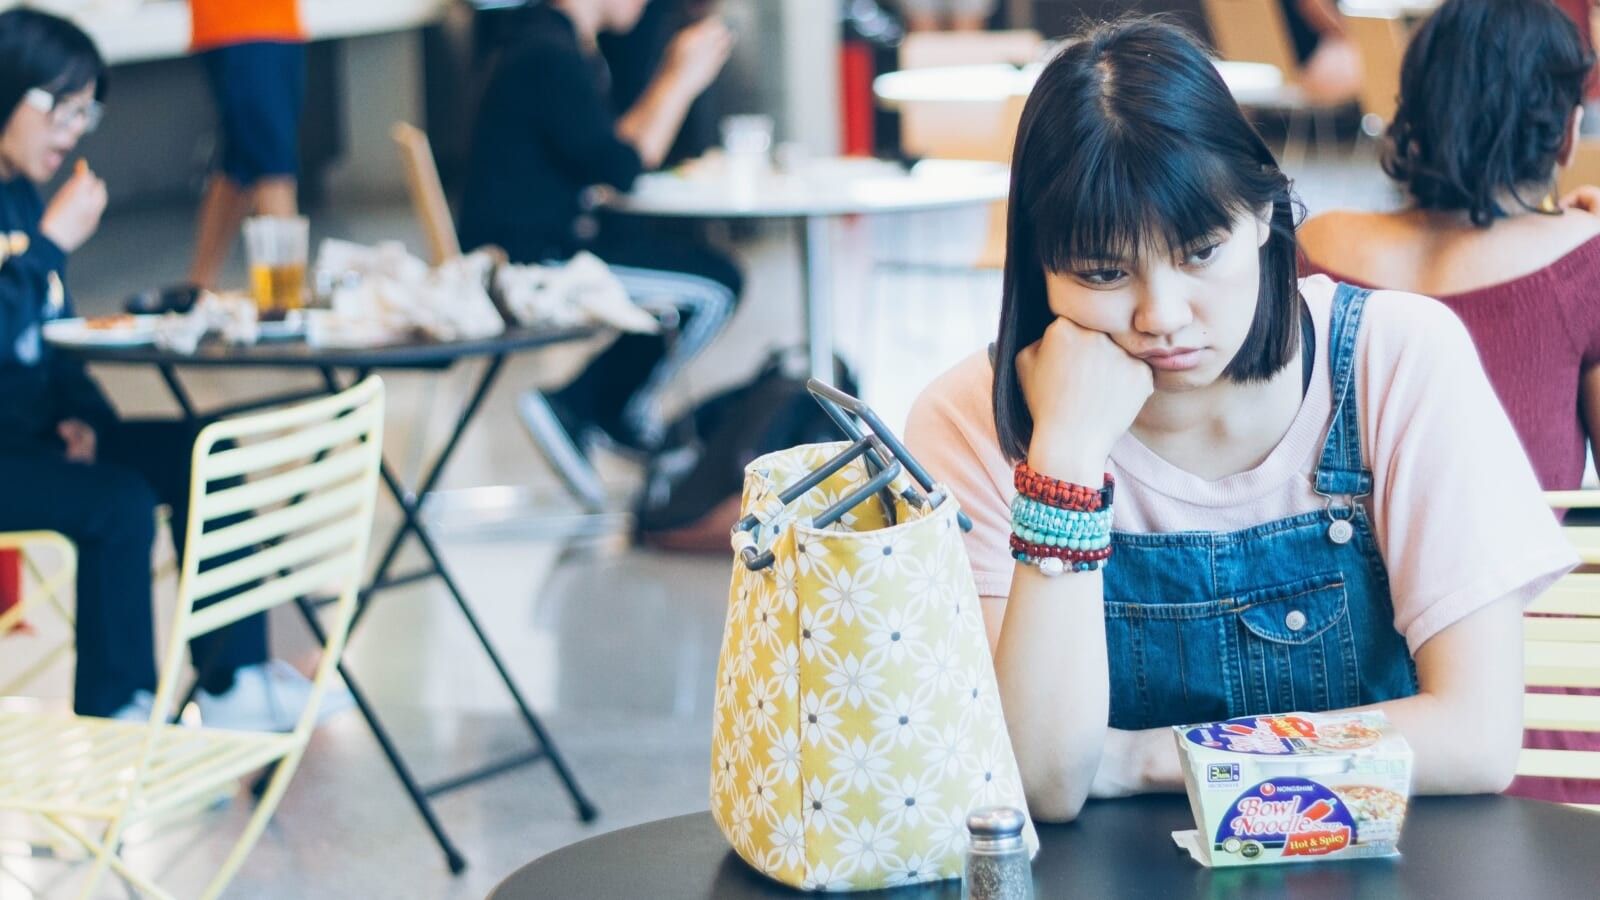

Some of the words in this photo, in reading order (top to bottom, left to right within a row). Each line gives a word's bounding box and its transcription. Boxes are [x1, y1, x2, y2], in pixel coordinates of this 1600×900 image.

[1238, 795, 1301, 817] Bowl
[1231, 815, 1312, 835] Noodle
[1290, 840, 1308, 849] Hot
[1310, 838, 1318, 846] &
[1319, 834, 1345, 846] Spicy
